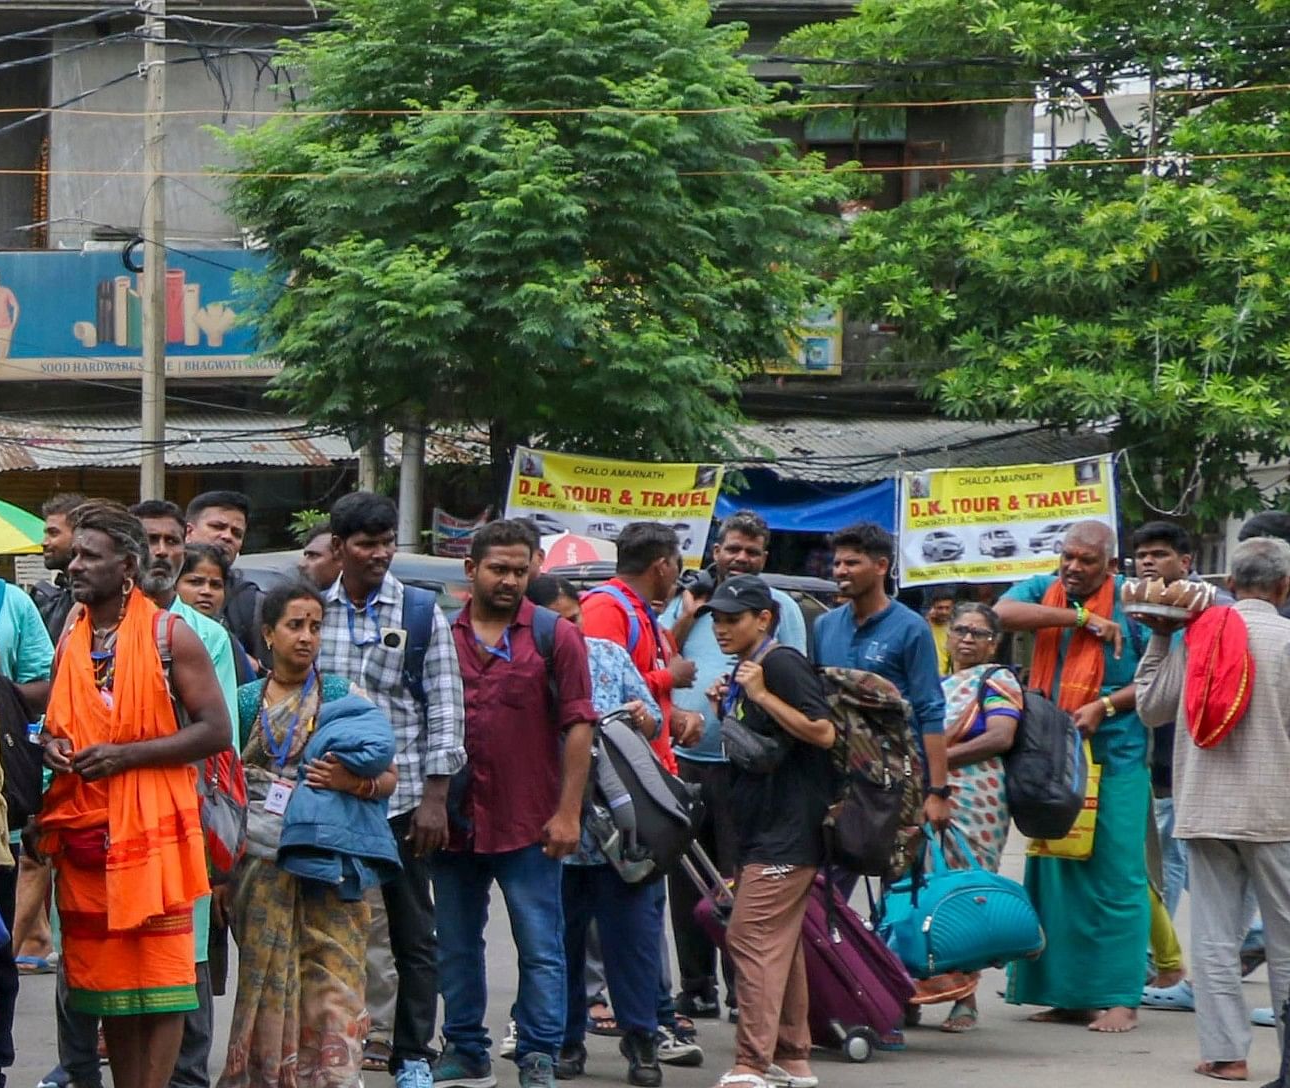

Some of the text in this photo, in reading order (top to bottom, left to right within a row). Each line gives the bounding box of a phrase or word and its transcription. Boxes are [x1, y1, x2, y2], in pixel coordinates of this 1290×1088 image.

[40, 362, 70, 373] SOOD
[72, 362, 134, 373] HARDWARE
[184, 360, 242, 372] BHAGWATI
[573, 465, 665, 480] CHALO AMARNATH
[958, 472, 1044, 486] CHALO AMARNATH
[518, 479, 712, 508] D.K. TOUR & TRAVEL
[910, 488, 1102, 518] D.K. TOUR & TRAVEL
